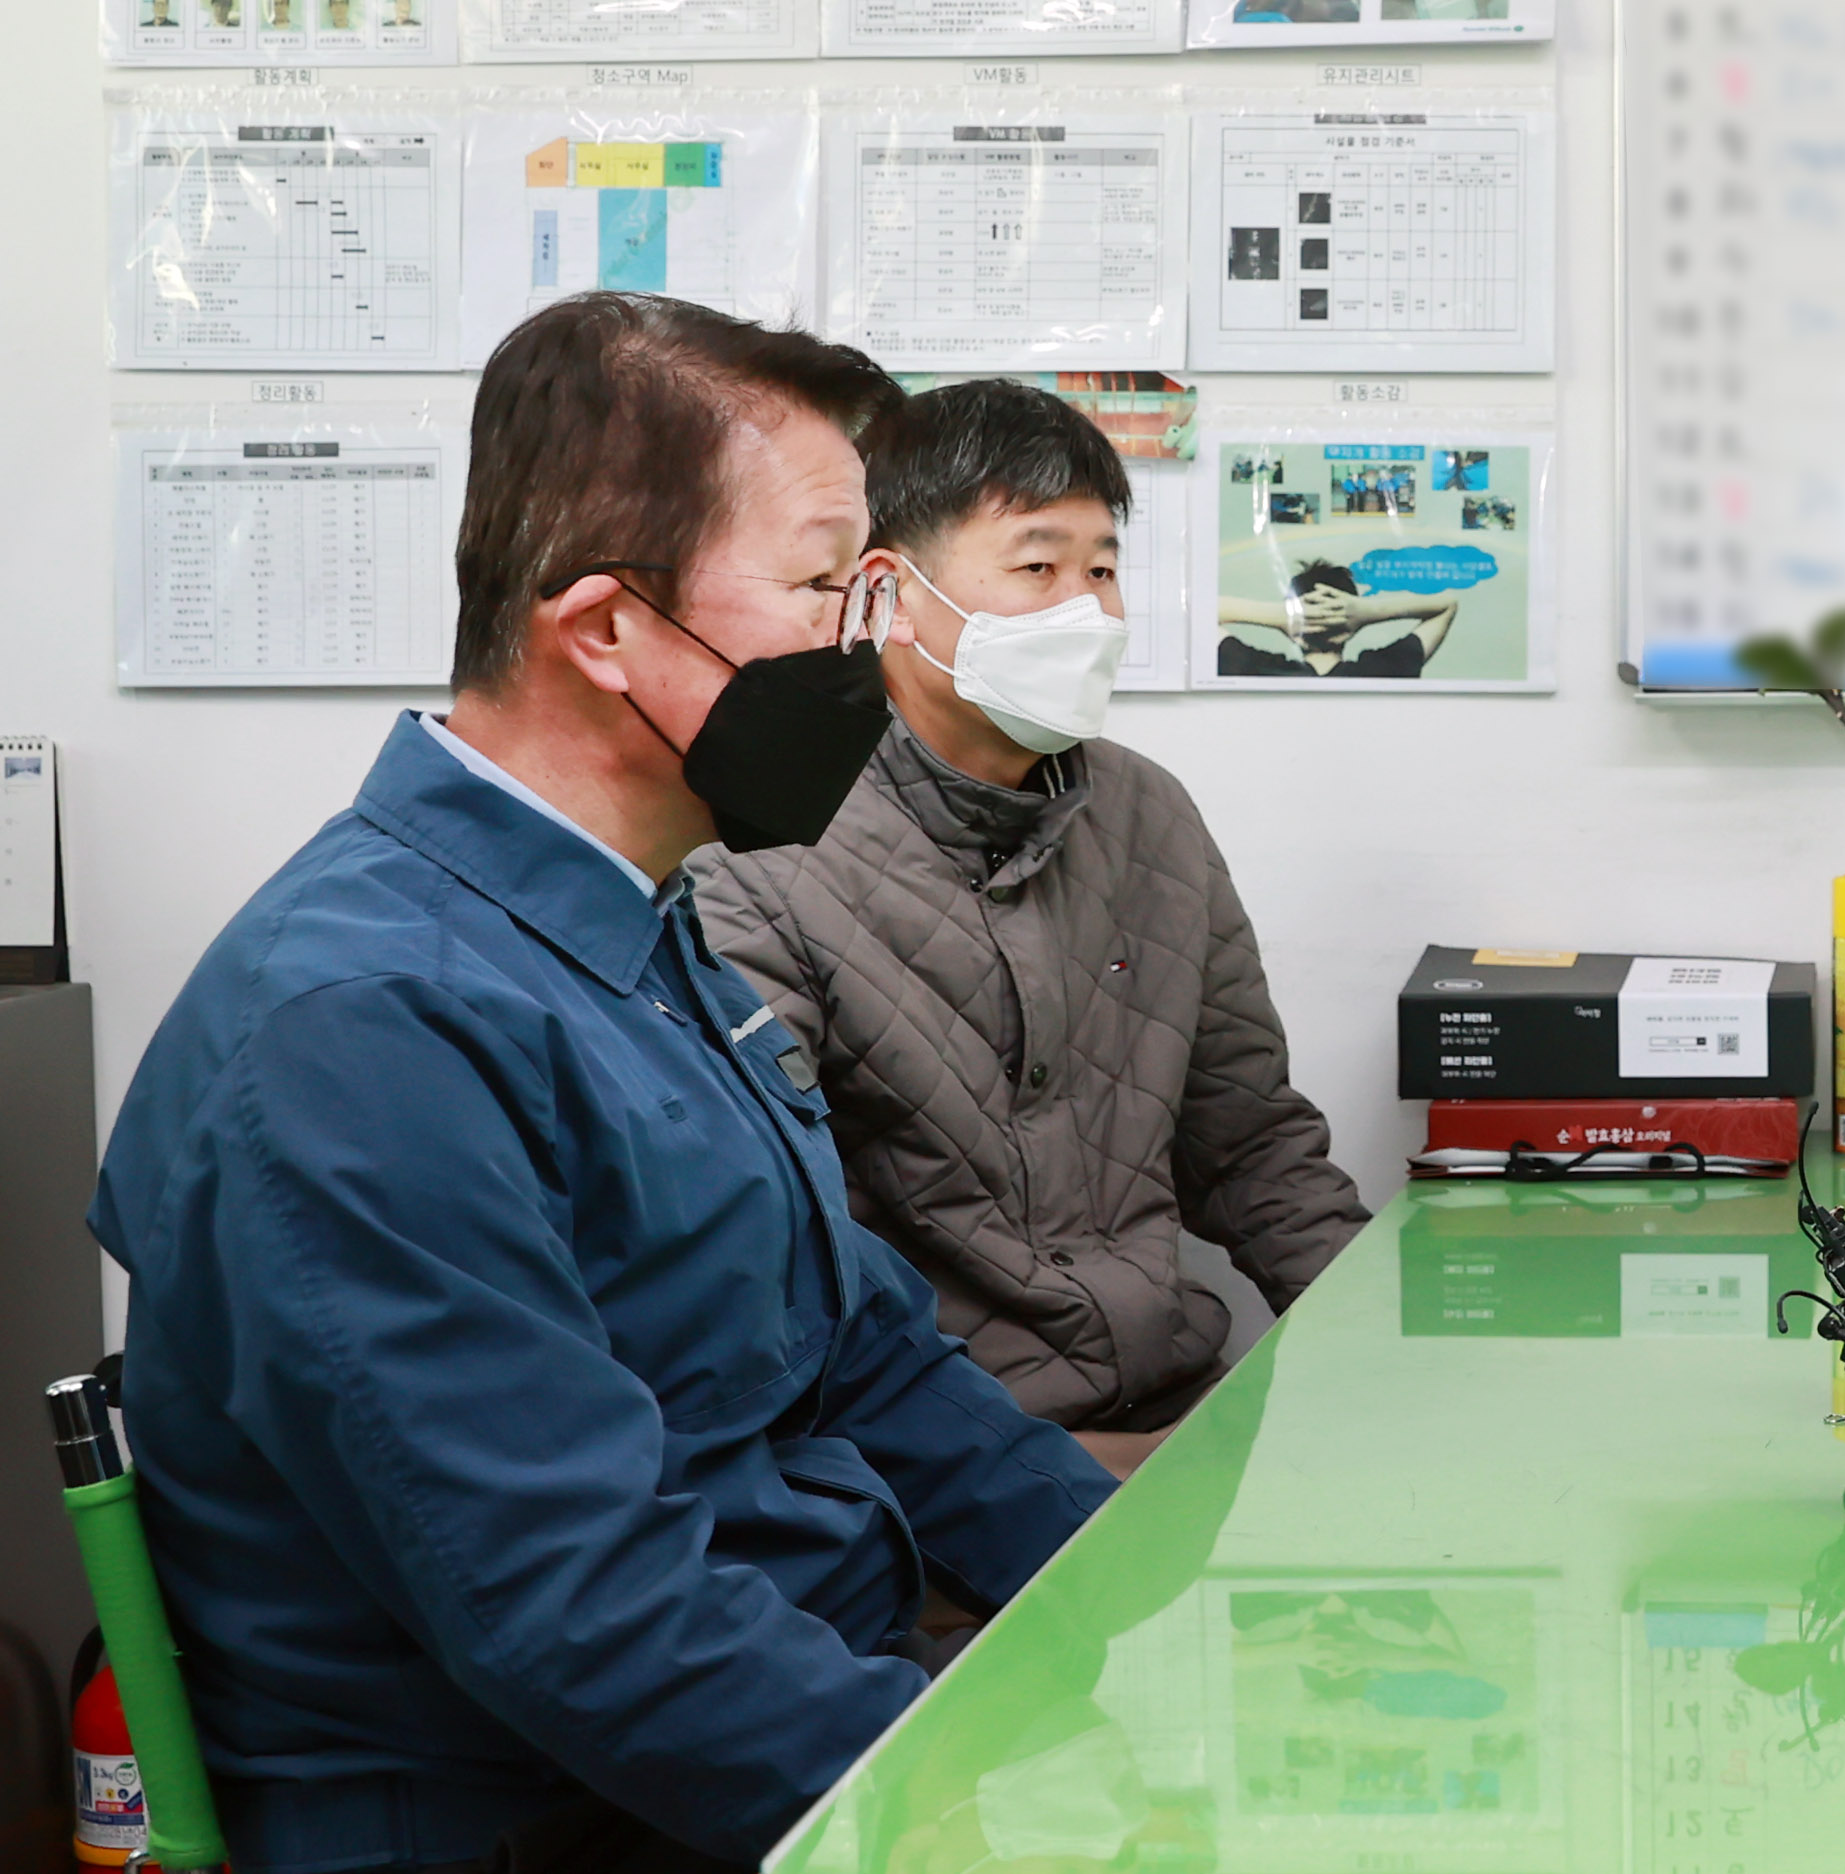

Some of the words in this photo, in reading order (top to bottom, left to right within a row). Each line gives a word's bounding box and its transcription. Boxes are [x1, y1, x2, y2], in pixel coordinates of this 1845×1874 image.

[255, 68, 311, 86] 활동계획
[592, 68, 651, 86] 청소구역
[657, 69, 689, 86] Map
[973, 67, 1026, 84] VM활동
[1323, 67, 1416, 85] 유지관리시트
[259, 384, 316, 401] 정리활동
[1341, 384, 1401, 401] 활동소감
[1584, 1127, 1635, 1144] 발효홍삼
